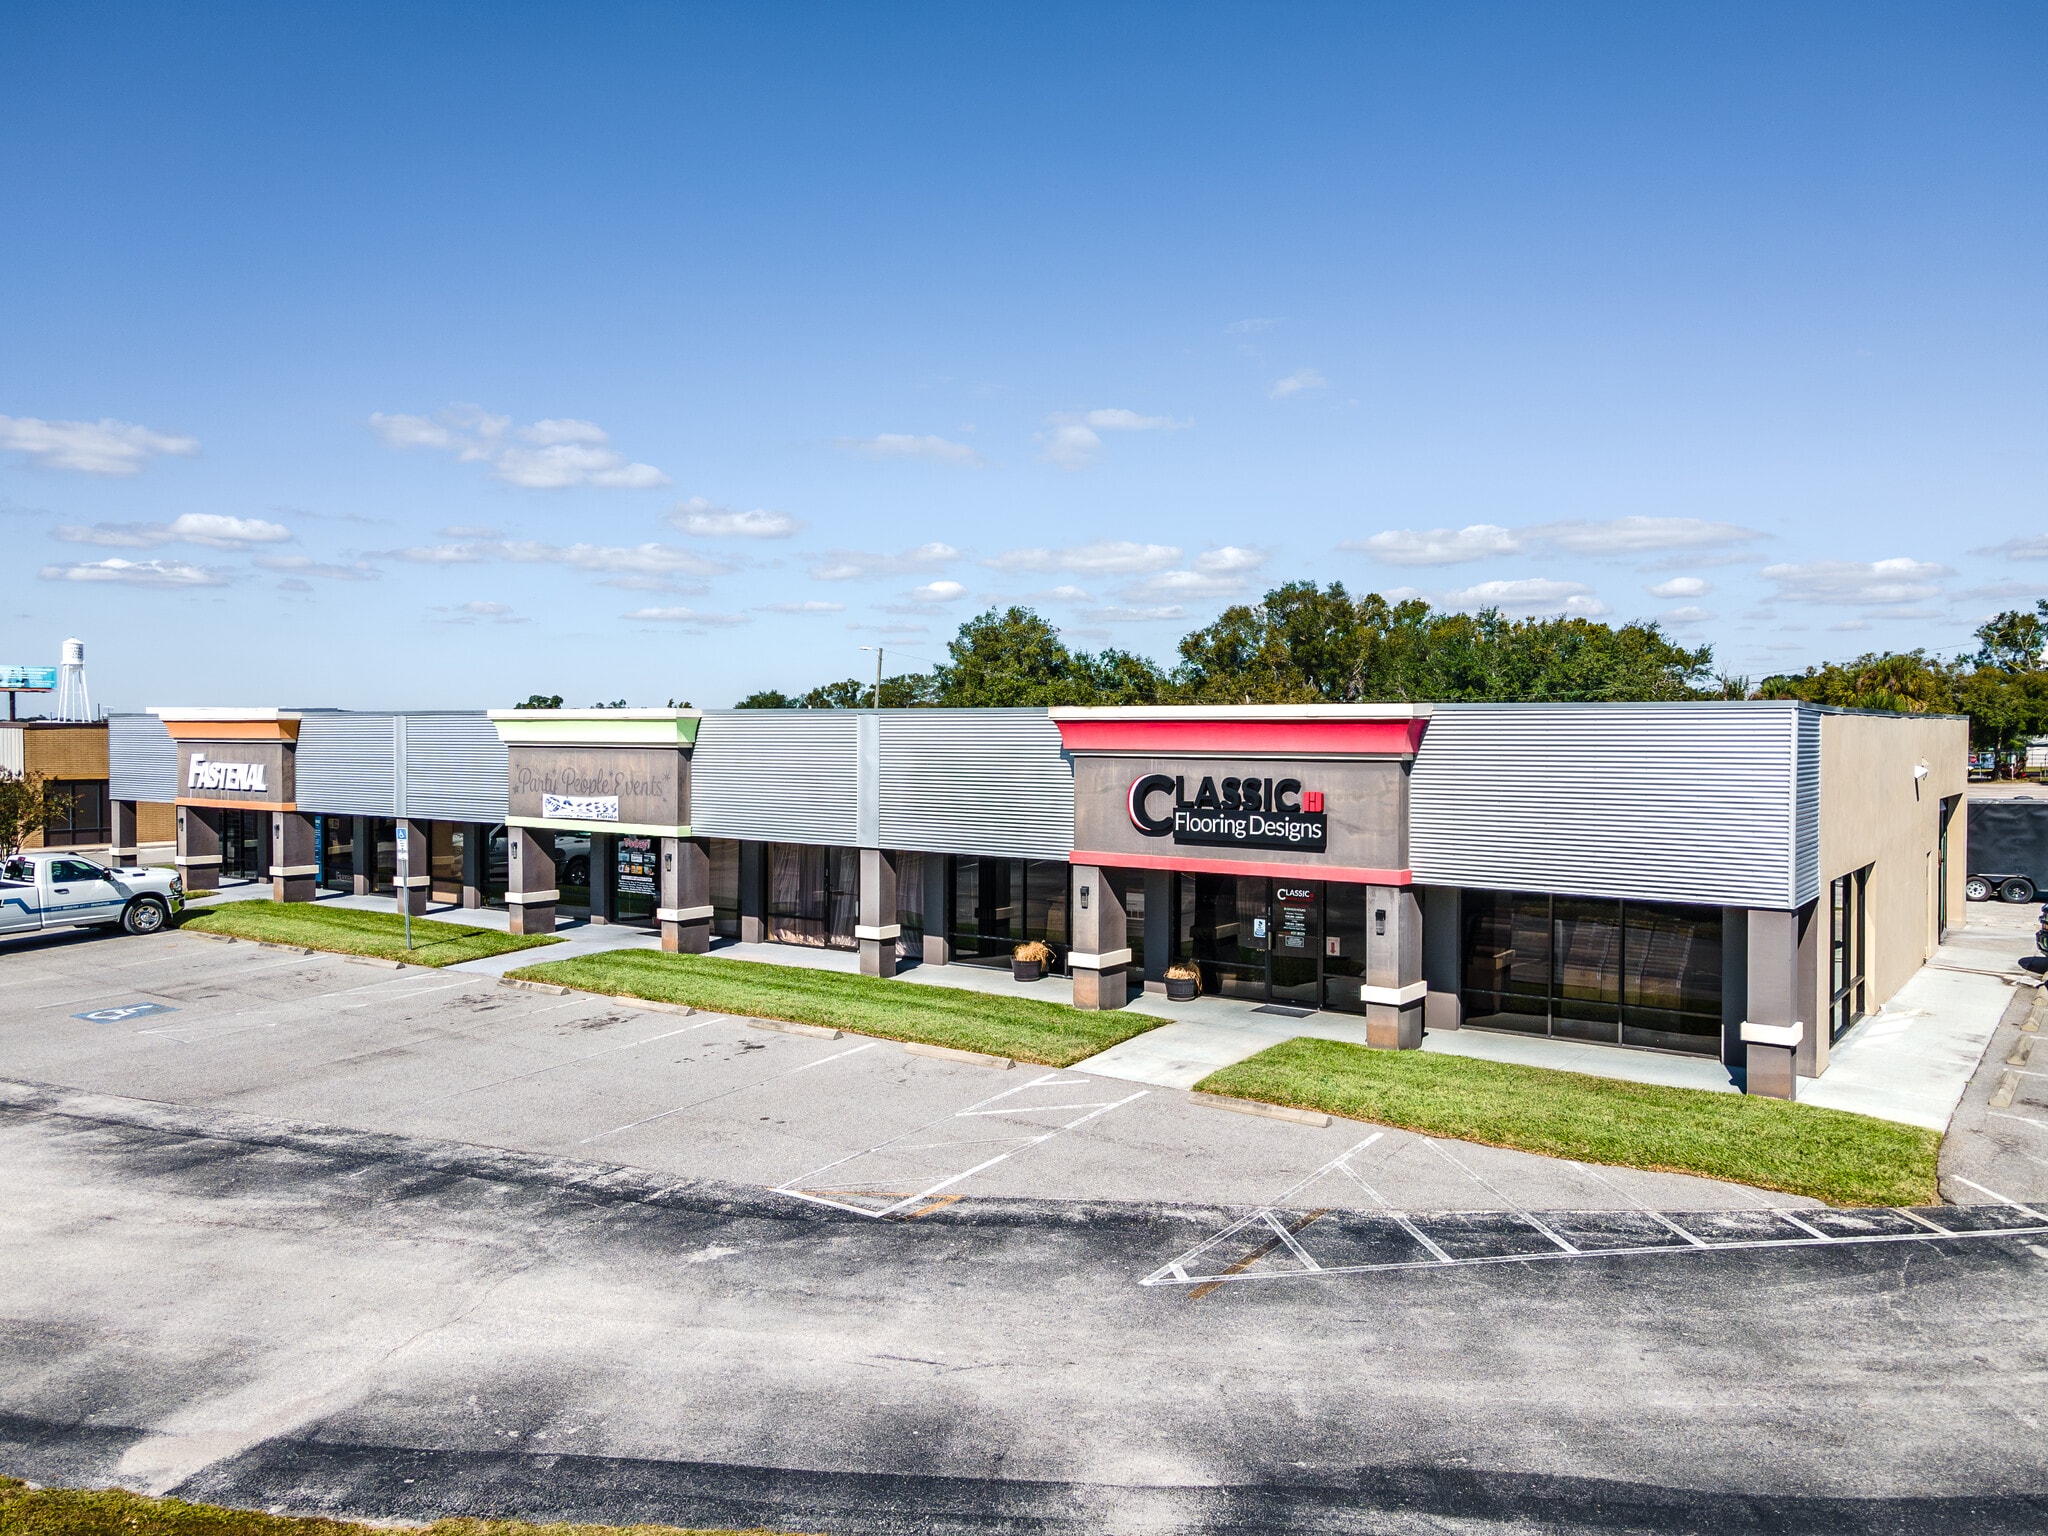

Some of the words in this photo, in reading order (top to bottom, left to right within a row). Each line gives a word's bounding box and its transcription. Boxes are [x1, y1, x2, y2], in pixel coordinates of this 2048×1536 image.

[188, 753, 268, 792] FASTENAL
[518, 767, 558, 796] Party
[561, 767, 610, 798] People
[613, 771, 664, 798] Events
[1127, 773, 1302, 837] CLASSIC
[1175, 812, 1247, 838] Flooring
[1250, 815, 1322, 842] Designs
[1277, 888, 1311, 901] CLASSIC
